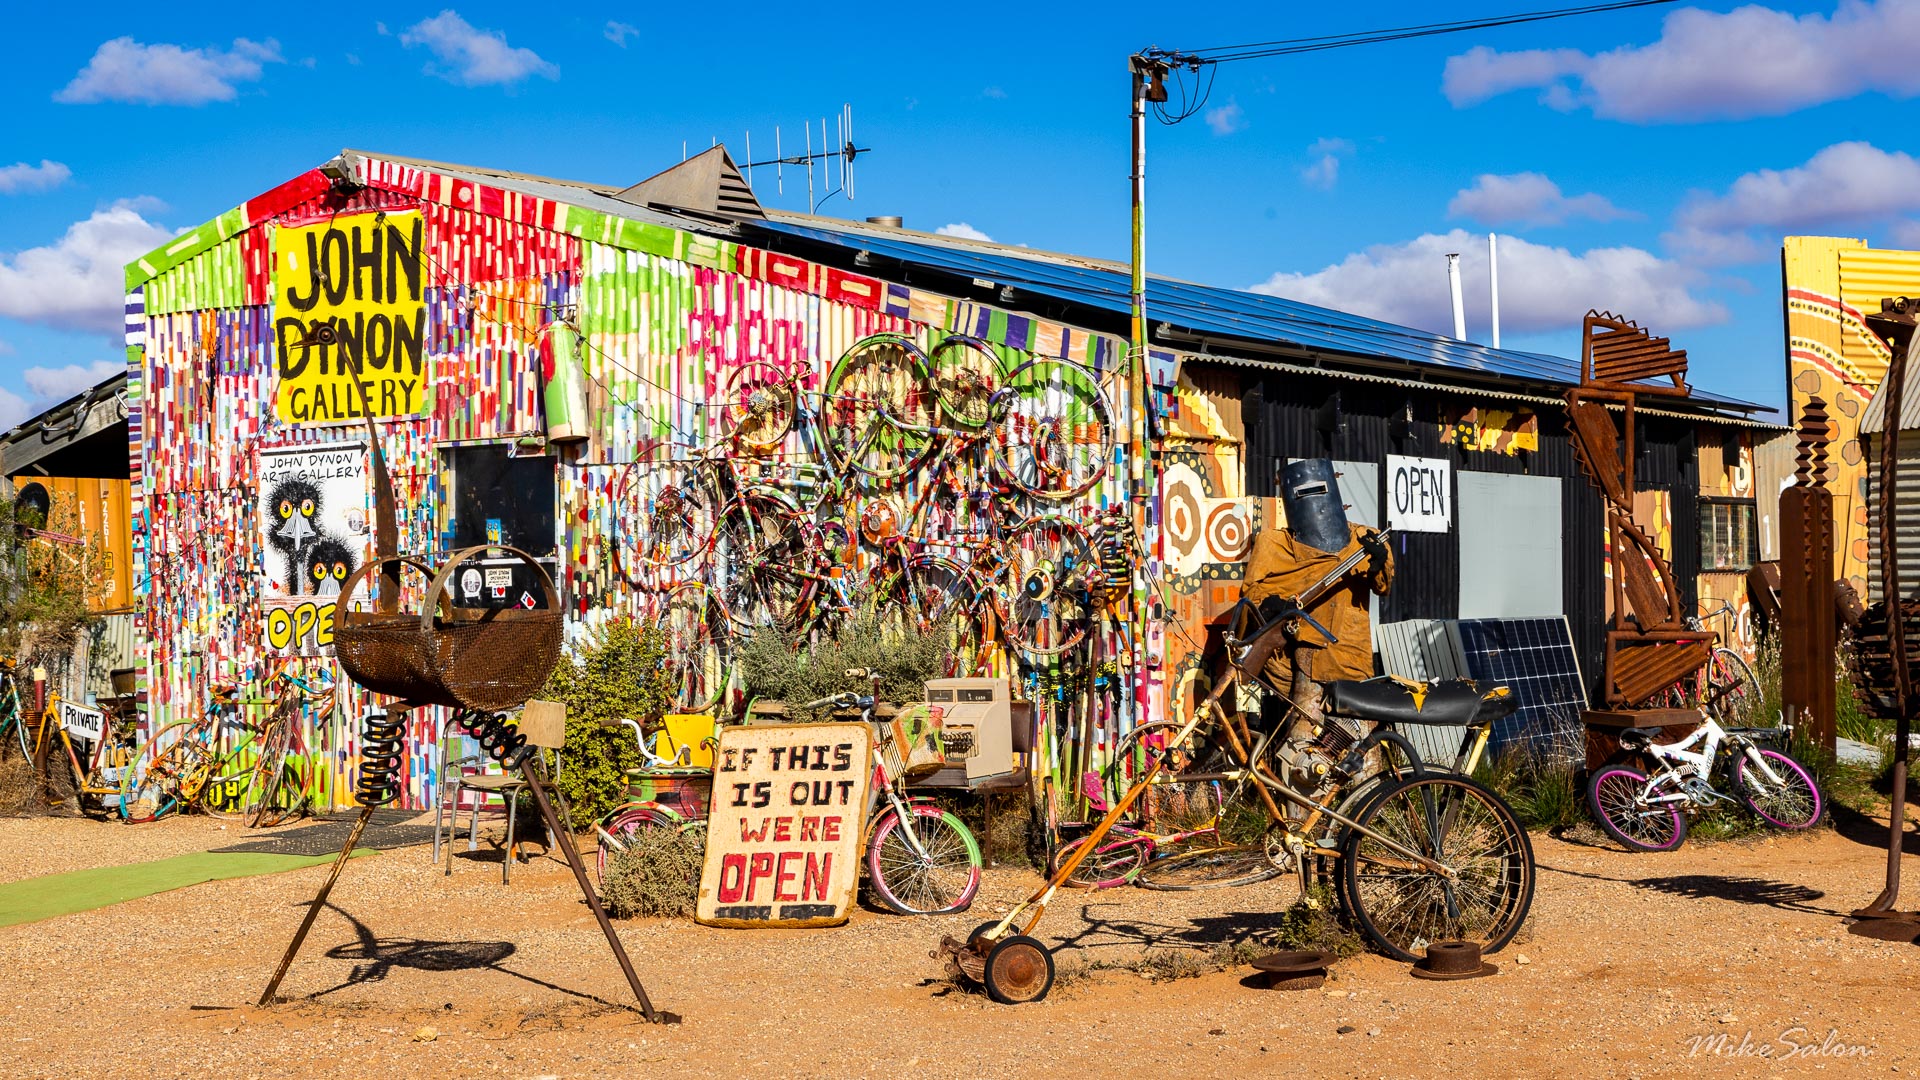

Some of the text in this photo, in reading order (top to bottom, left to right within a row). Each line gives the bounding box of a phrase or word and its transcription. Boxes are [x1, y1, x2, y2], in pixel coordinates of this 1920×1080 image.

[287, 217, 423, 312] JOHN
[276, 306, 426, 380] DYNON
[291, 379, 416, 421] GALLERY
[261, 466, 362, 483] ART GALLERY
[270, 453, 353, 469] JOHN DYNON
[1395, 466, 1444, 516] OPEN
[268, 601, 361, 649] OPE
[65, 706, 99, 732] PRIVATE
[720, 744, 852, 772] IF THIS
[731, 780, 854, 808] IS OUT
[717, 852, 833, 903] OPEN
